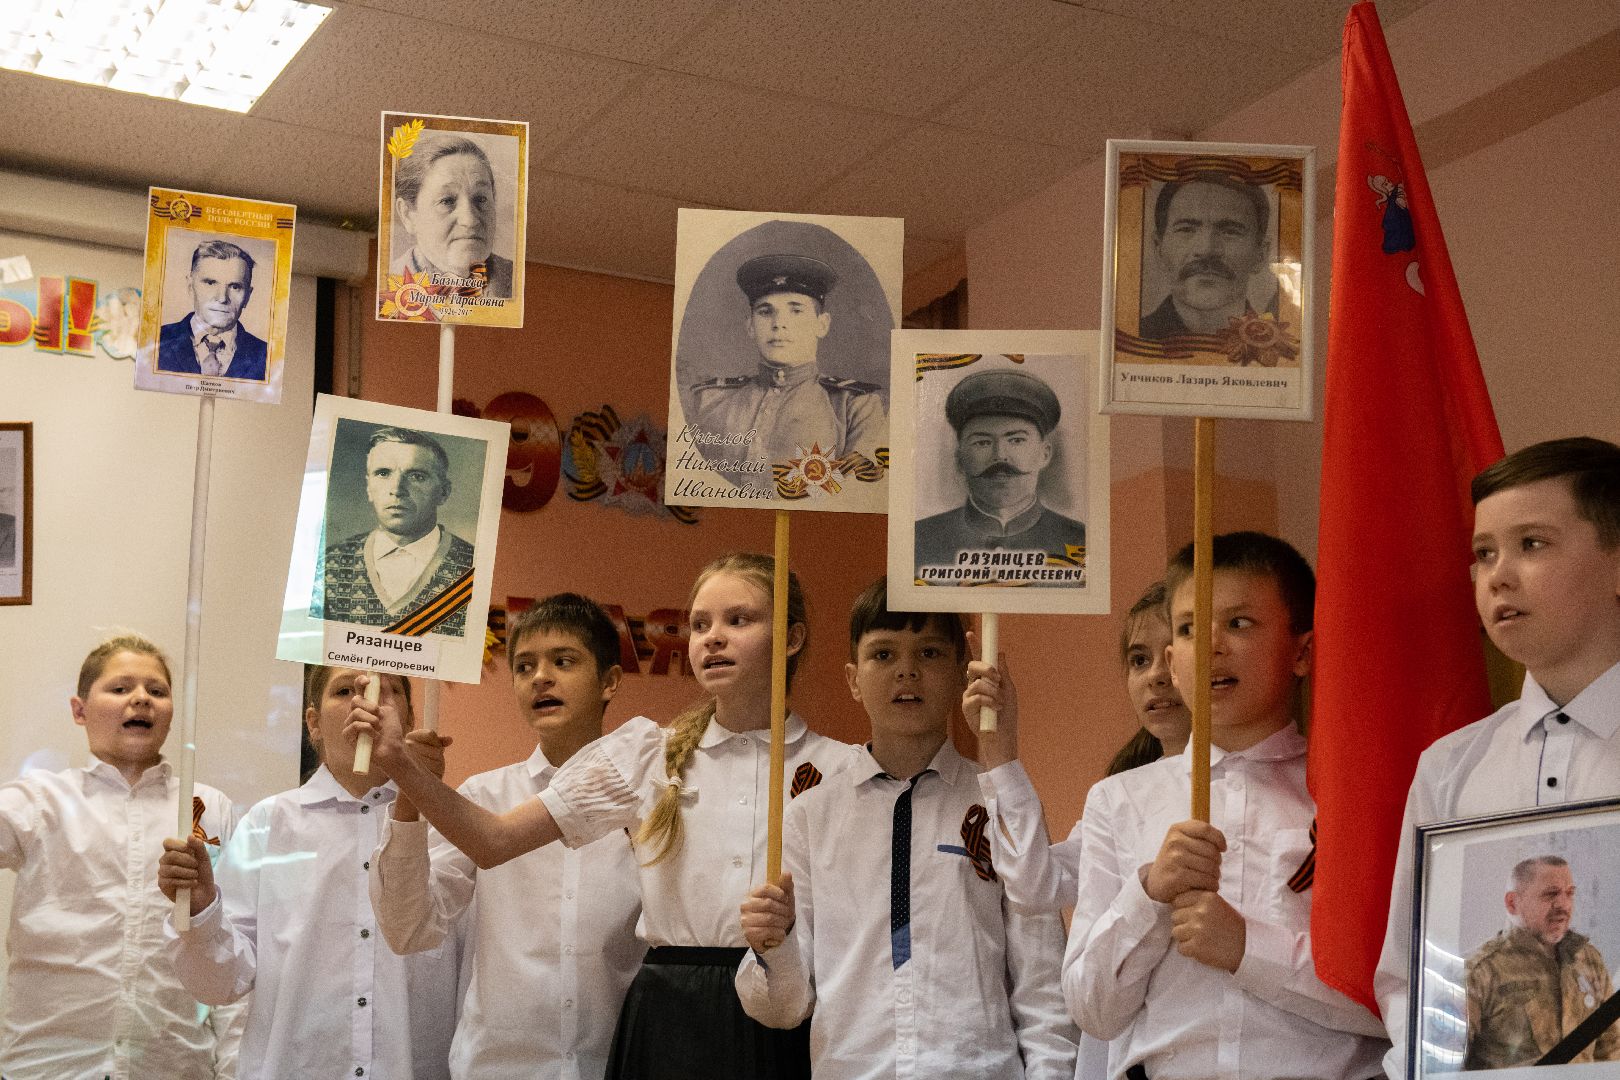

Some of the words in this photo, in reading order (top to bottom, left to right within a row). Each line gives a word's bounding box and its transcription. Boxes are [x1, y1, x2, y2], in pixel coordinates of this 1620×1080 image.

[207, 214, 232, 224] ПОЛК
[234, 217, 271, 229] РОССИИ
[409, 290, 446, 305] Мария
[449, 293, 505, 308] Тарасовна
[1176, 374, 1219, 387] Лазарь
[1221, 376, 1288, 389] Яковлевич
[676, 424, 757, 450] Крылов
[675, 450, 768, 473] Николай
[673, 477, 773, 500] Иванович
[958, 552, 1045, 567] РЯЗАНЦЕВ
[921, 567, 991, 580] ГРИГОРИЙ
[997, 569, 1083, 581] АЛЕКСЕЕВИЧ
[346, 631, 423, 653] Рязанцев
[327, 651, 363, 664] Семён
[366, 656, 435, 673] Григорьевич
